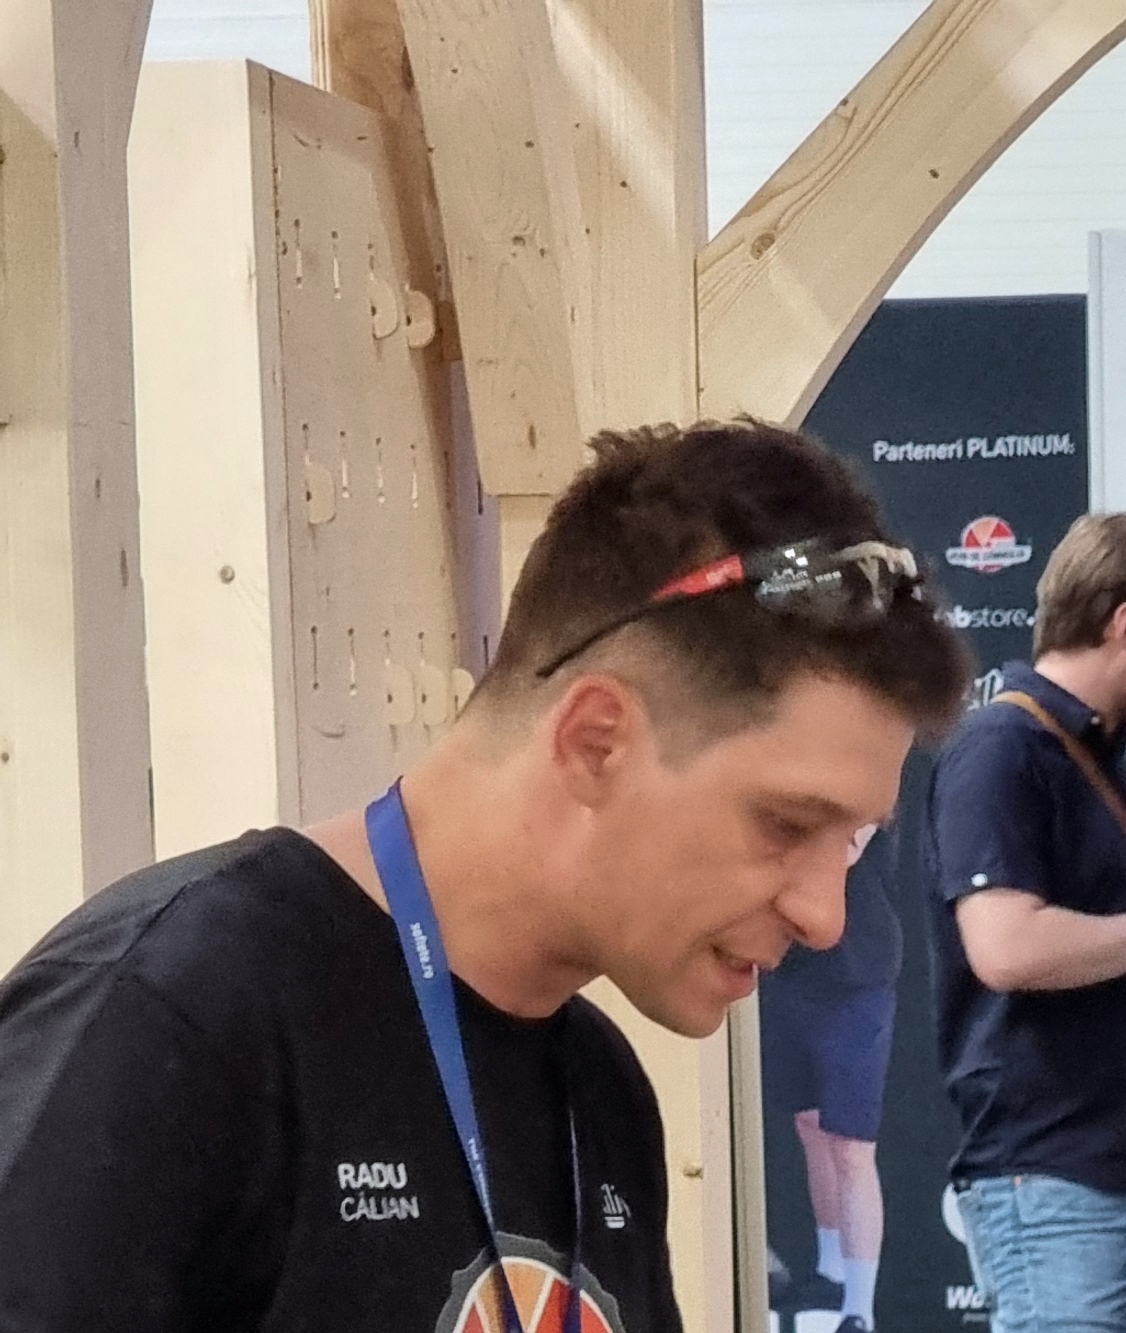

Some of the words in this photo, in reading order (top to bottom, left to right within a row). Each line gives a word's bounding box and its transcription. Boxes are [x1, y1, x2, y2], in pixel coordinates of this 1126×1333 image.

[873, 439, 963, 462] Parteneri
[966, 432, 1075, 459] PLATINUM:
[337, 1162, 408, 1190] RADU
